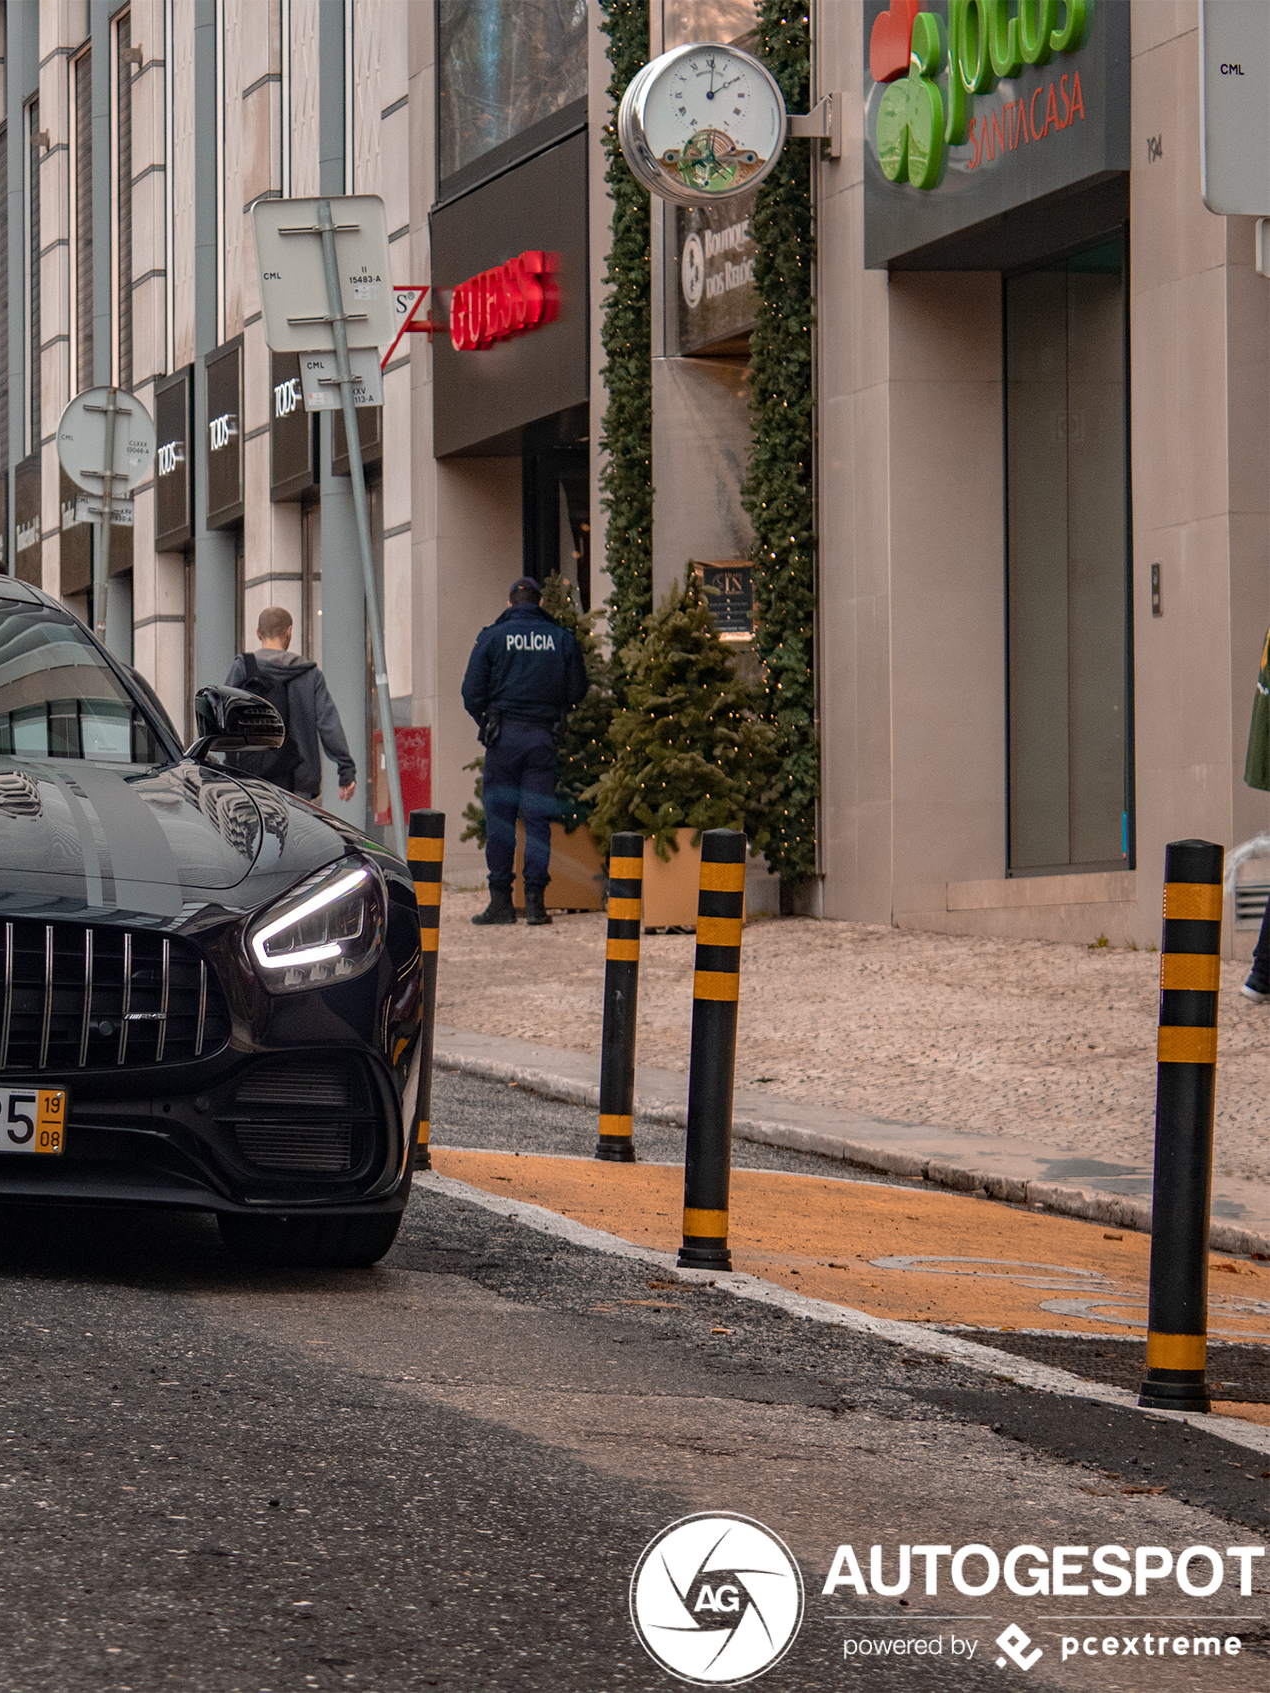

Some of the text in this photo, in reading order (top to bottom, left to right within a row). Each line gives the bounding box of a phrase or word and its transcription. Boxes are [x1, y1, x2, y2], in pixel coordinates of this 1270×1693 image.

[1220, 63, 1245, 76] CML
[263, 272, 281, 280] CML
[450, 251, 543, 351] GUESS
[506, 631, 556, 651] POLÍCIA
[44, 1096, 61, 1114] 19
[40, 1130, 61, 1147] 08
